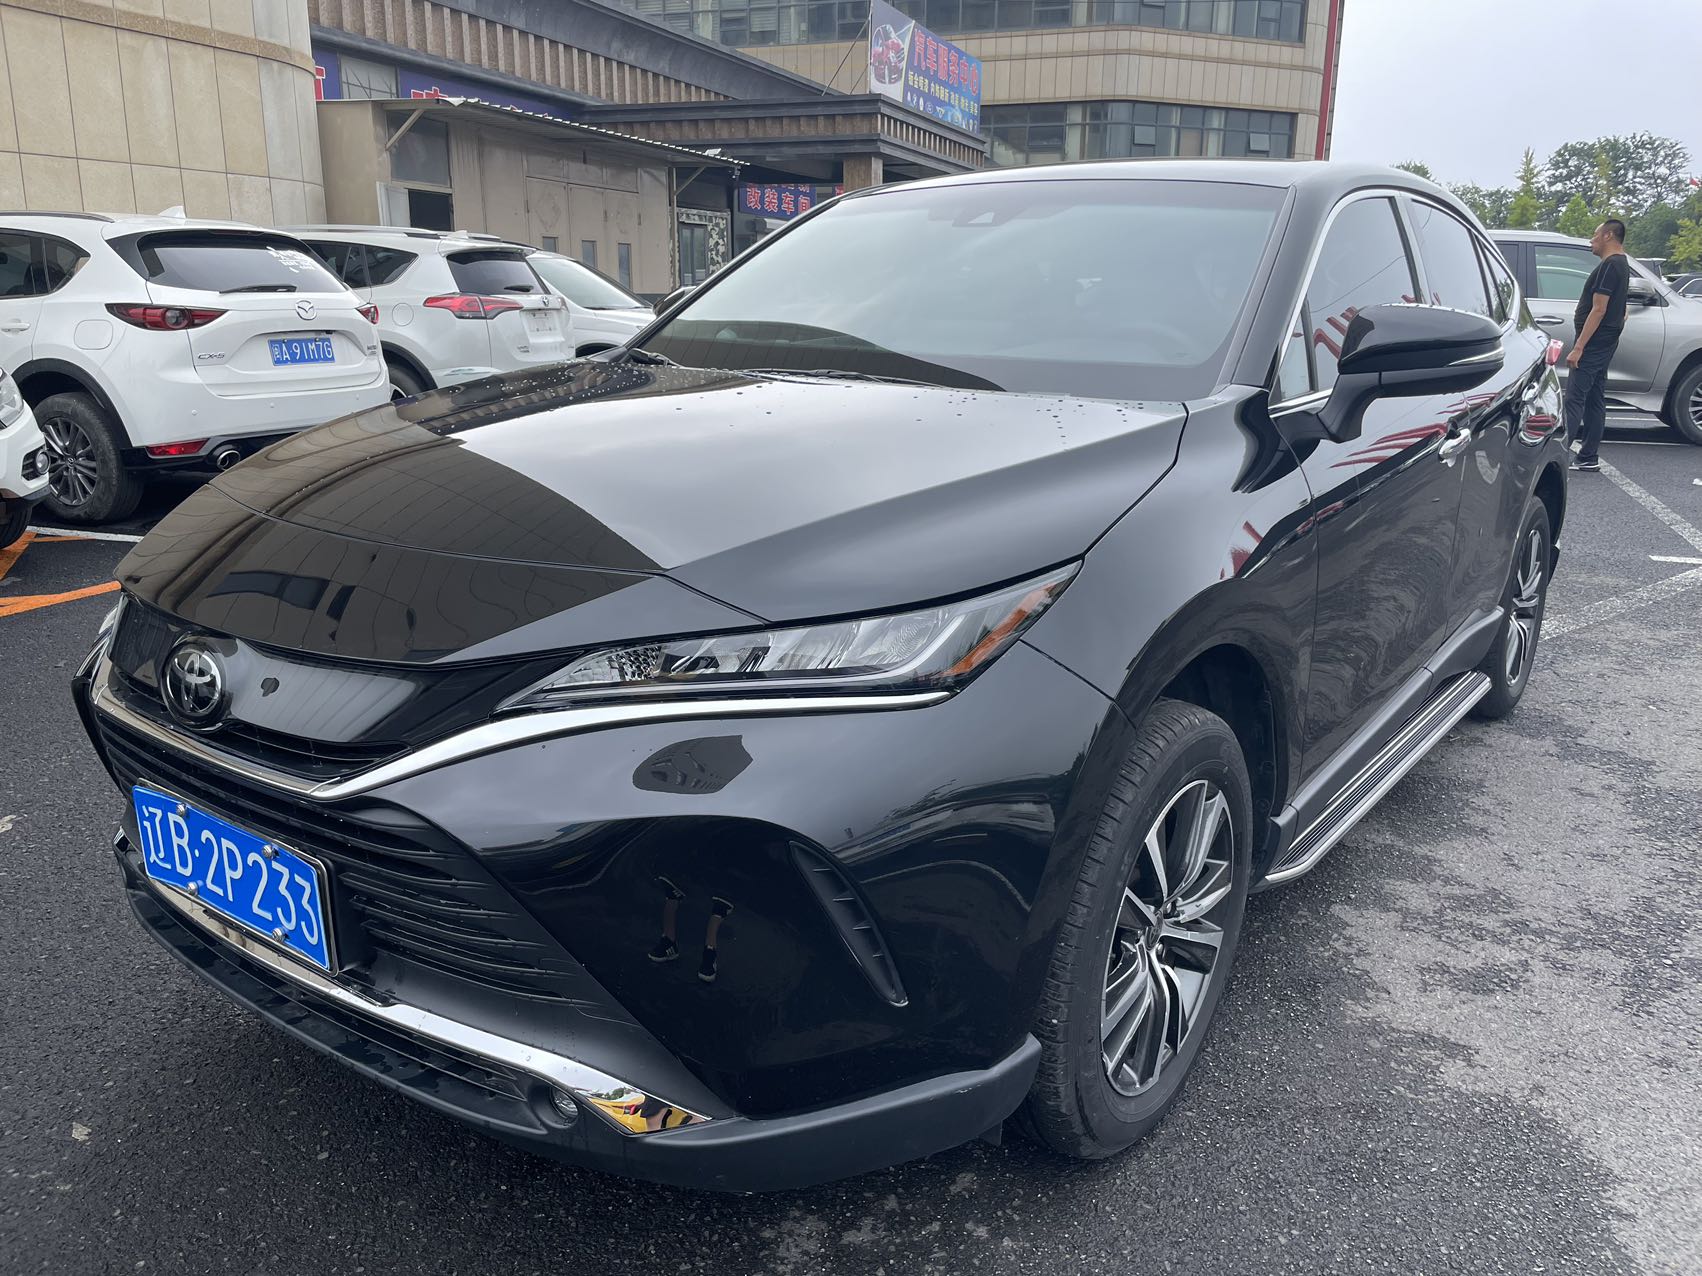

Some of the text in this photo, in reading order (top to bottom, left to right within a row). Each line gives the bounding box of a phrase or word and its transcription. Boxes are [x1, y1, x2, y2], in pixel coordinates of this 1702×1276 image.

[914, 28, 979, 97] 汽车服务中心
[747, 187, 811, 215] 改装车间
[142, 805, 319, 946] 辽B·2P233
